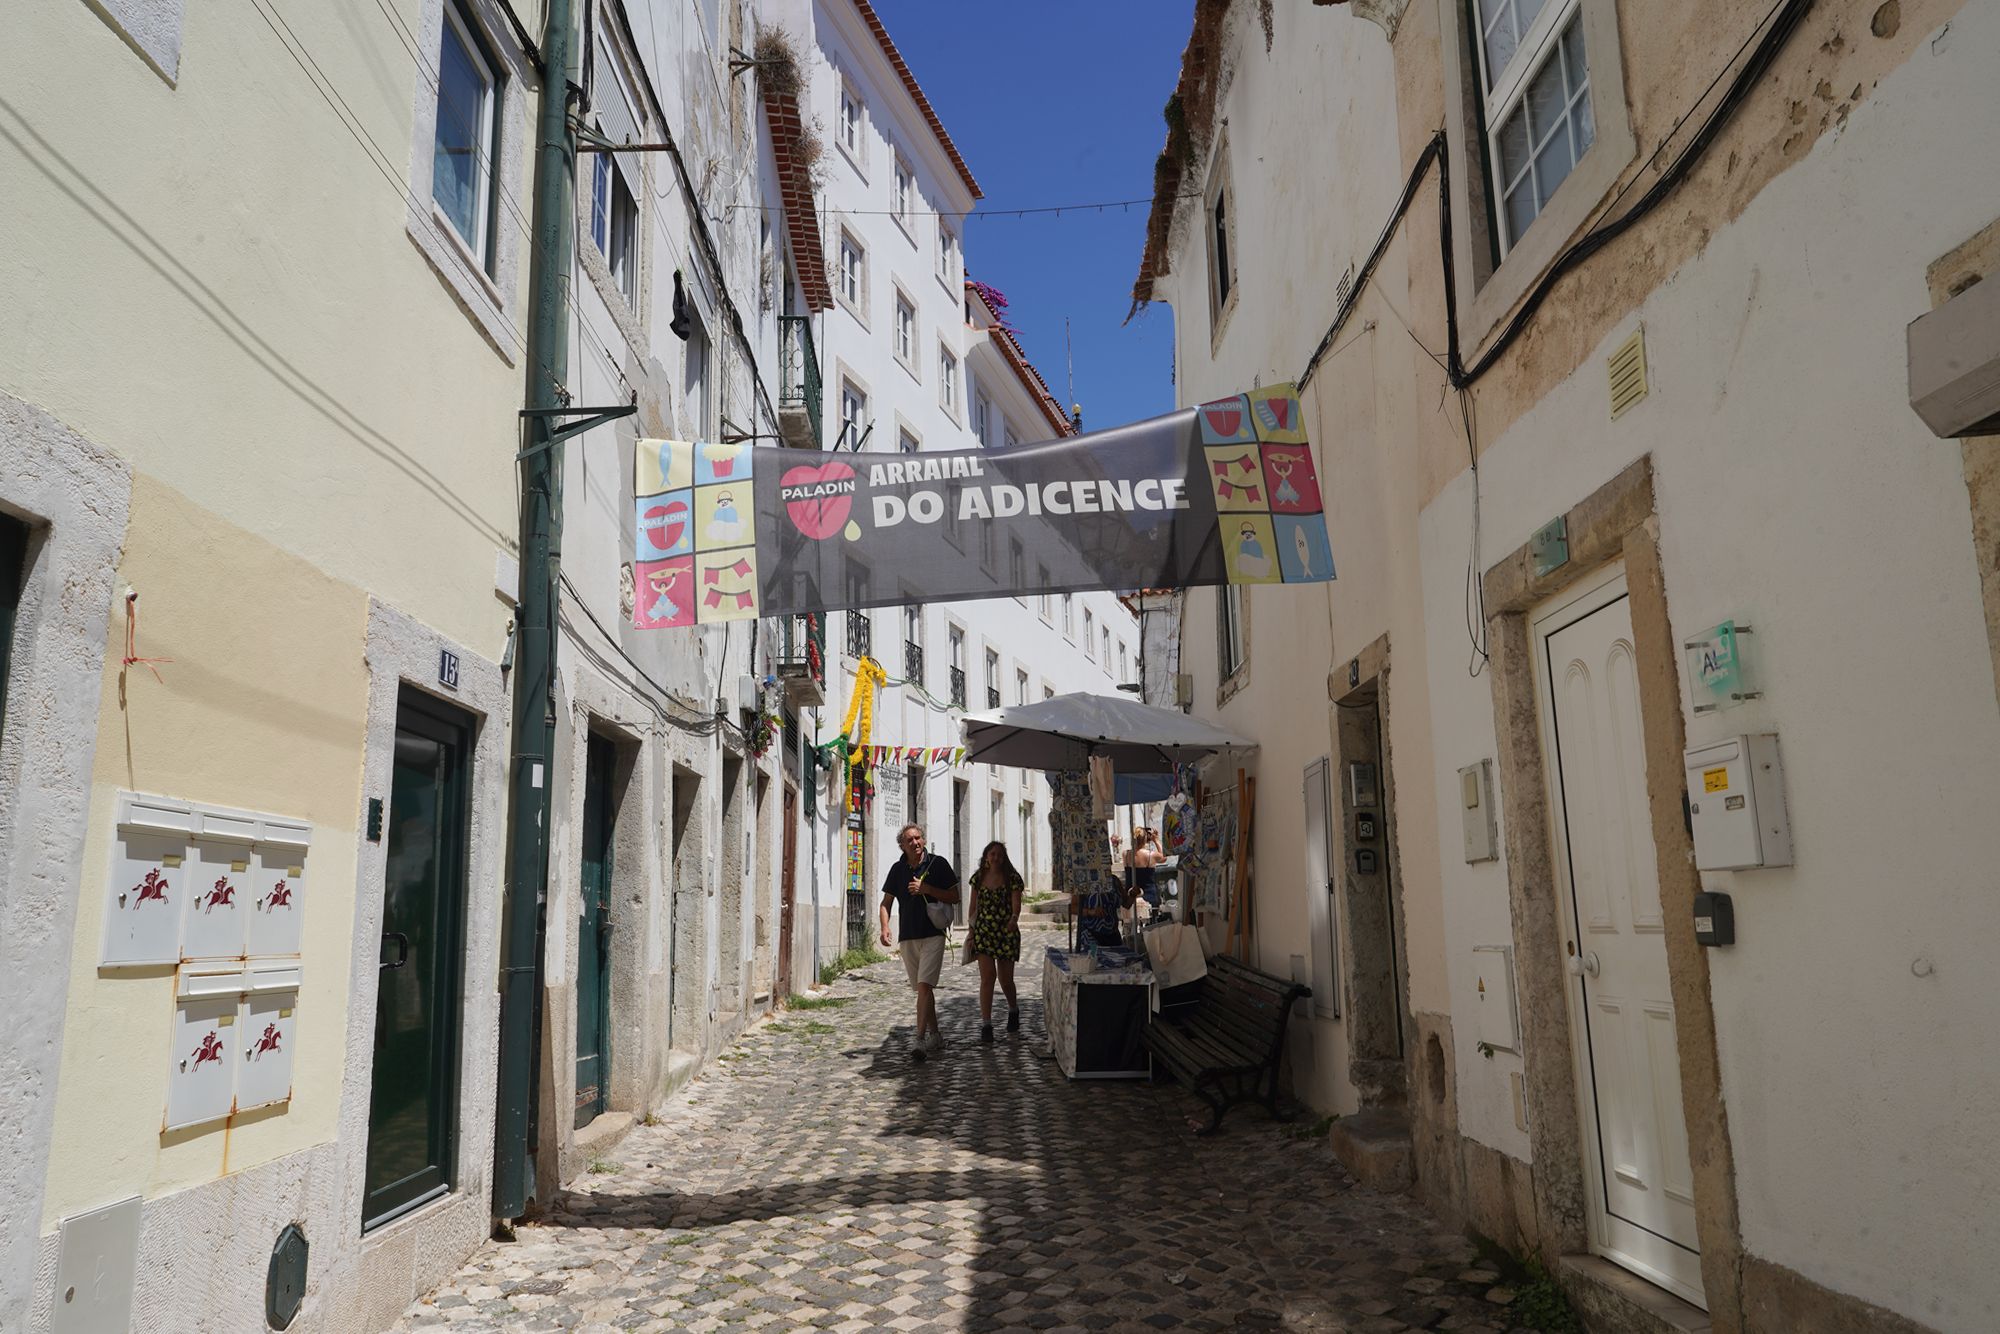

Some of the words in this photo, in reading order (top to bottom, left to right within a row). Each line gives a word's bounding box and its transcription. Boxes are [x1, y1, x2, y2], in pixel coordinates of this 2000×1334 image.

[1200, 401, 1243, 411] PALADIN
[869, 456, 984, 487] ARRAIAL
[782, 481, 856, 500] PALADIN
[872, 490, 944, 528] DO
[957, 479, 1190, 521] ADICENCE
[643, 511, 688, 528] PALADIN
